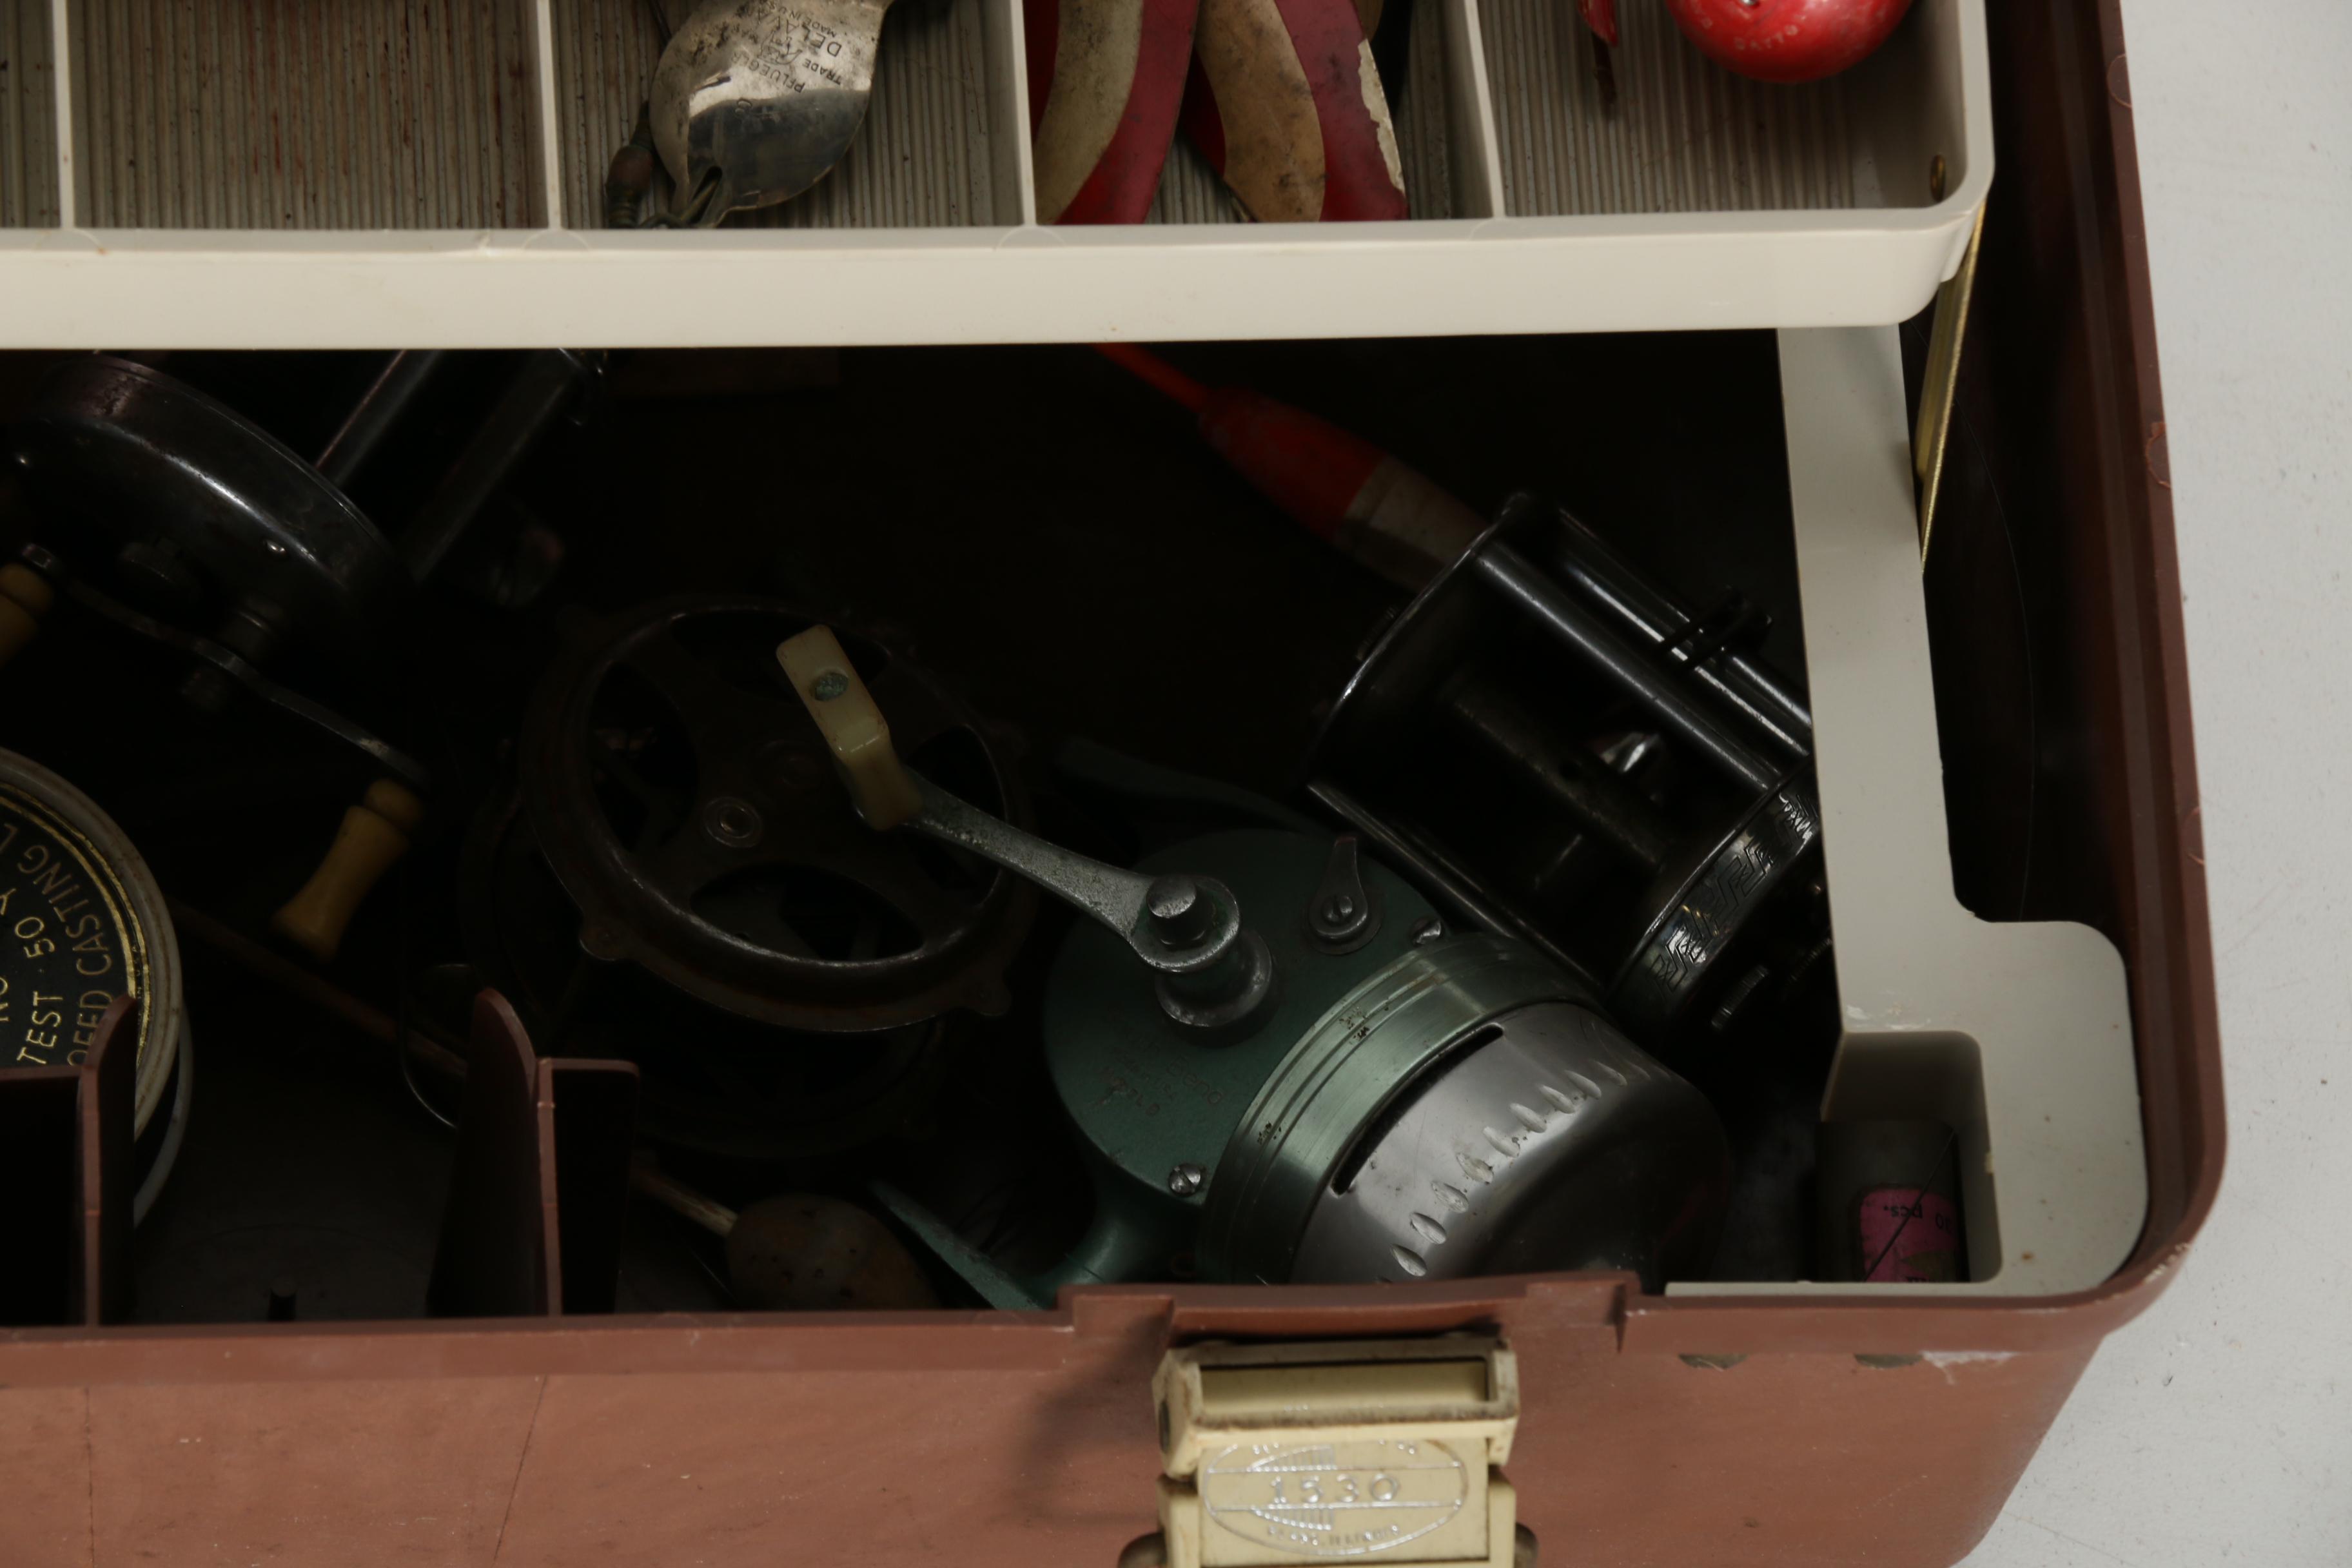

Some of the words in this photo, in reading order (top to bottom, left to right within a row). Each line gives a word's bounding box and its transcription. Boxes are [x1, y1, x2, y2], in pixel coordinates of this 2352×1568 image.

[731, 52, 805, 93] PFLUEGER
[802, 58, 841, 85] TRADE
[17, 844, 112, 977] CASTING
[14, 916, 56, 960] 50
[16, 990, 64, 1066] TEST
[1883, 1204, 1923, 1220] pcs.
[1268, 1473, 1402, 1504] 1530
